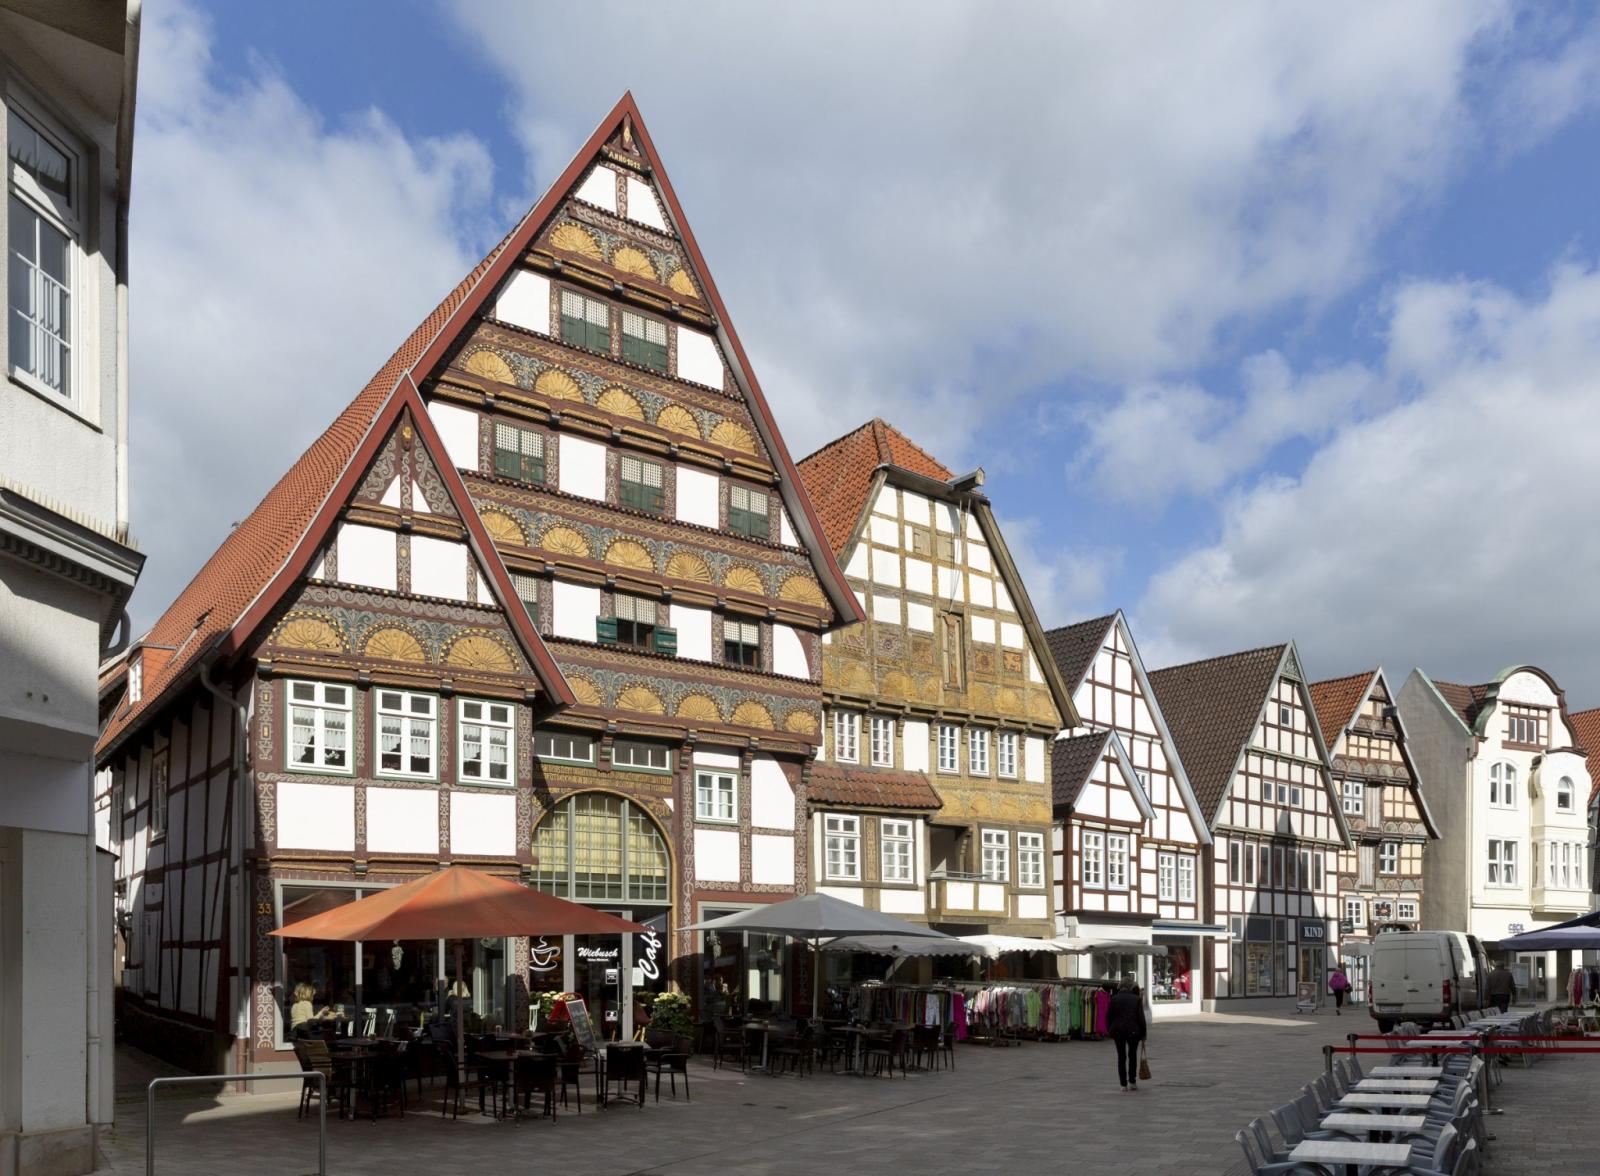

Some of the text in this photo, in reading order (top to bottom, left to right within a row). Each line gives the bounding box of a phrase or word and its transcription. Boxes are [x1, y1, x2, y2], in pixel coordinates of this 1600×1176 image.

[257, 903, 272, 914] 33
[1303, 926, 1324, 938] KIND
[577, 947, 618, 957] Wiebusch
